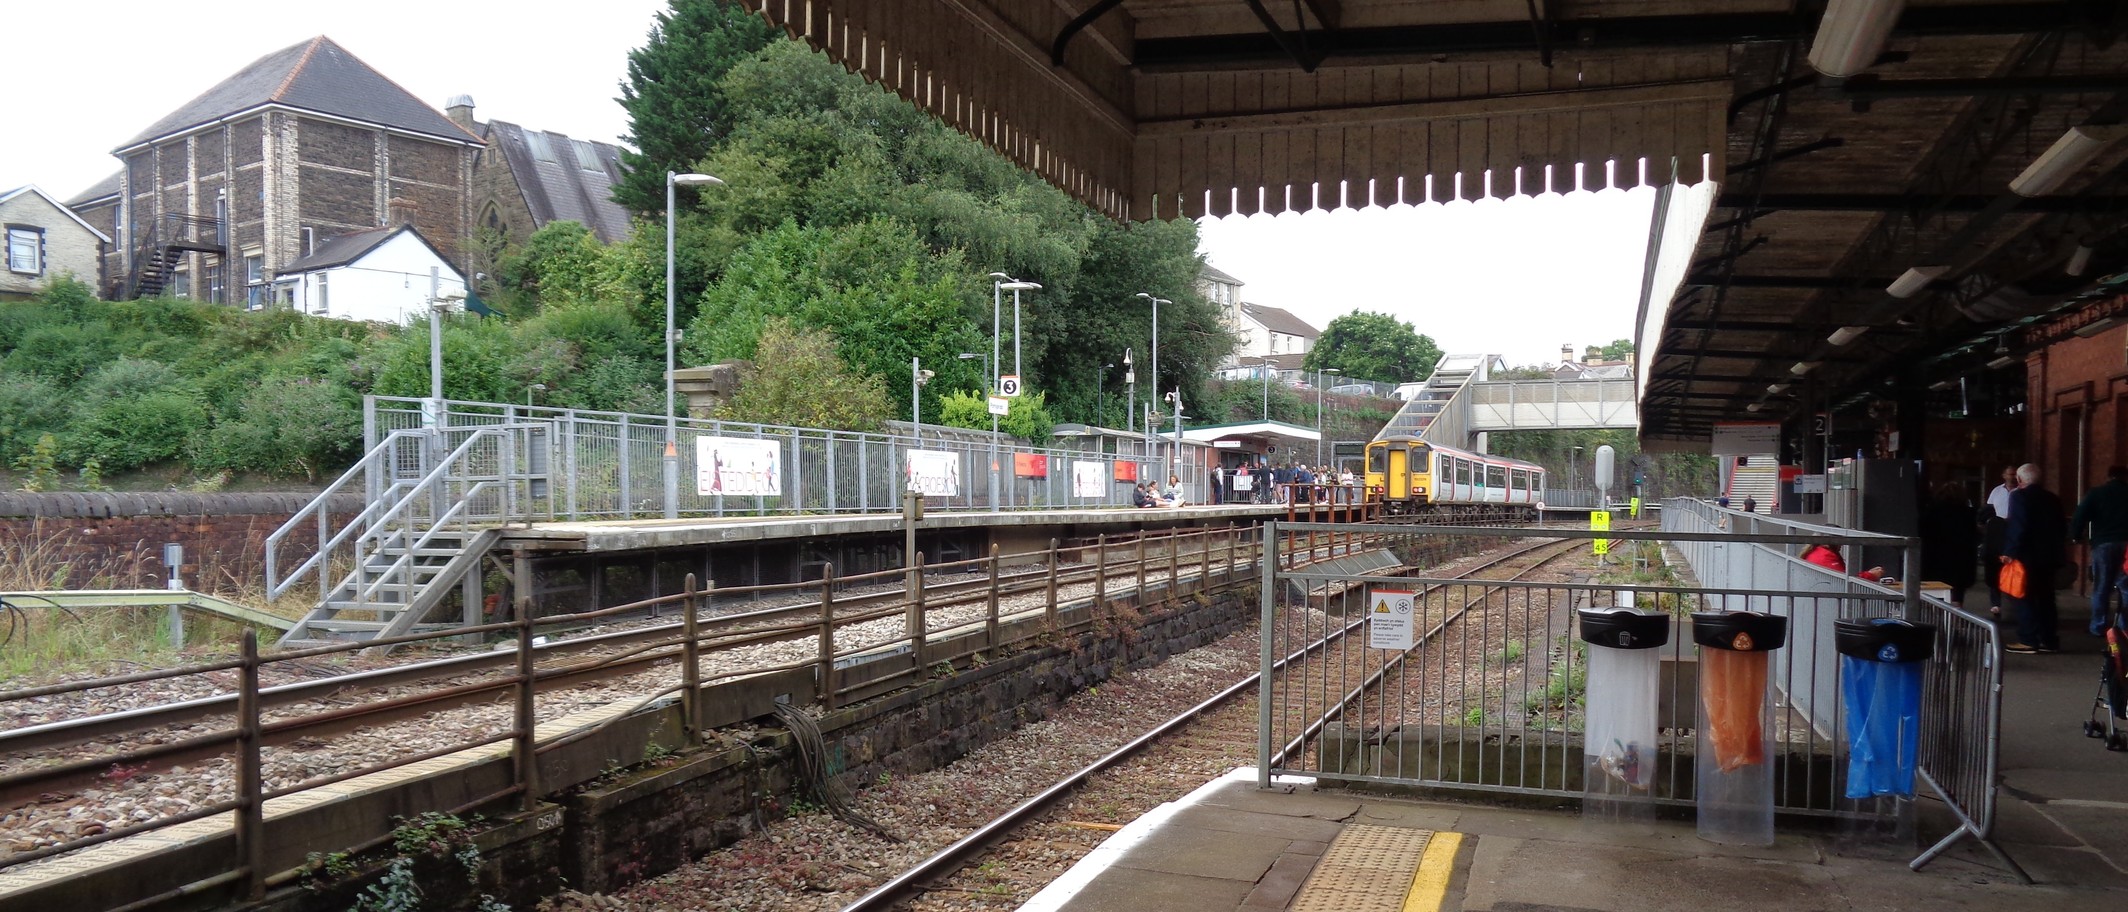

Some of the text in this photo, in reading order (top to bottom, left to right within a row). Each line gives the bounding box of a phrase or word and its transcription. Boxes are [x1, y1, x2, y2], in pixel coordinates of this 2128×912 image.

[1005, 381, 1014, 393] 3
[1816, 419, 1823, 430] 2
[1597, 513, 1603, 521] R
